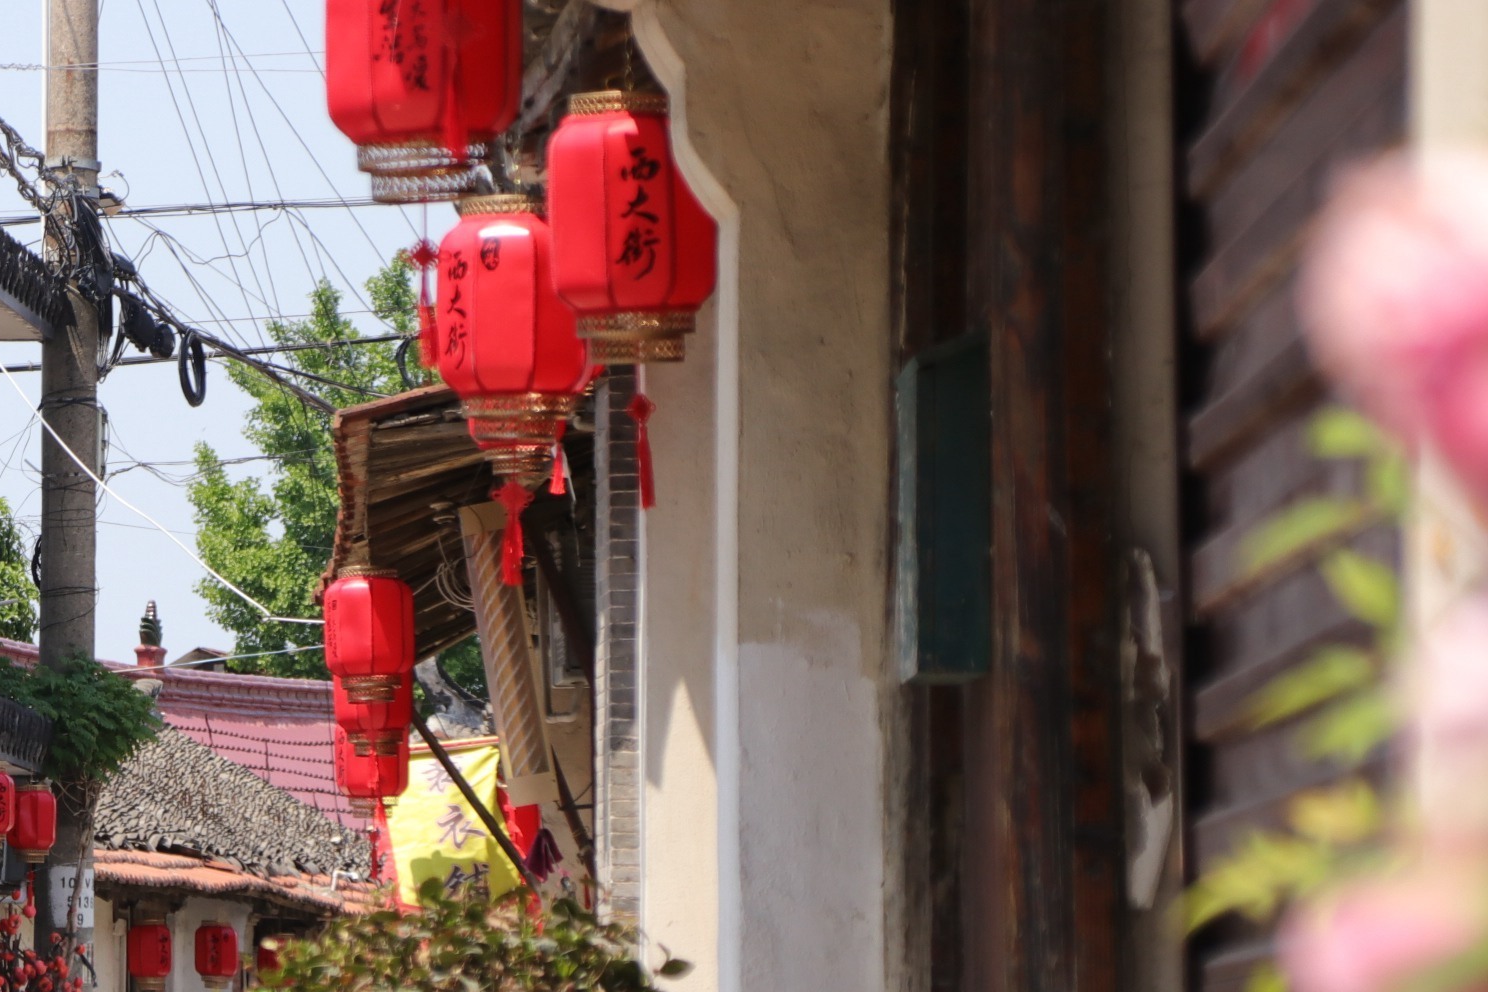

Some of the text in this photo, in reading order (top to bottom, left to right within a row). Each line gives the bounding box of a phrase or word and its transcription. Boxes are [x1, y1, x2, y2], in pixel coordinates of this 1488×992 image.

[615, 148, 661, 281] 西大街
[444, 249, 468, 370] 西大街
[61, 877, 91, 889] 10V
[77, 913, 84, 926] 9
